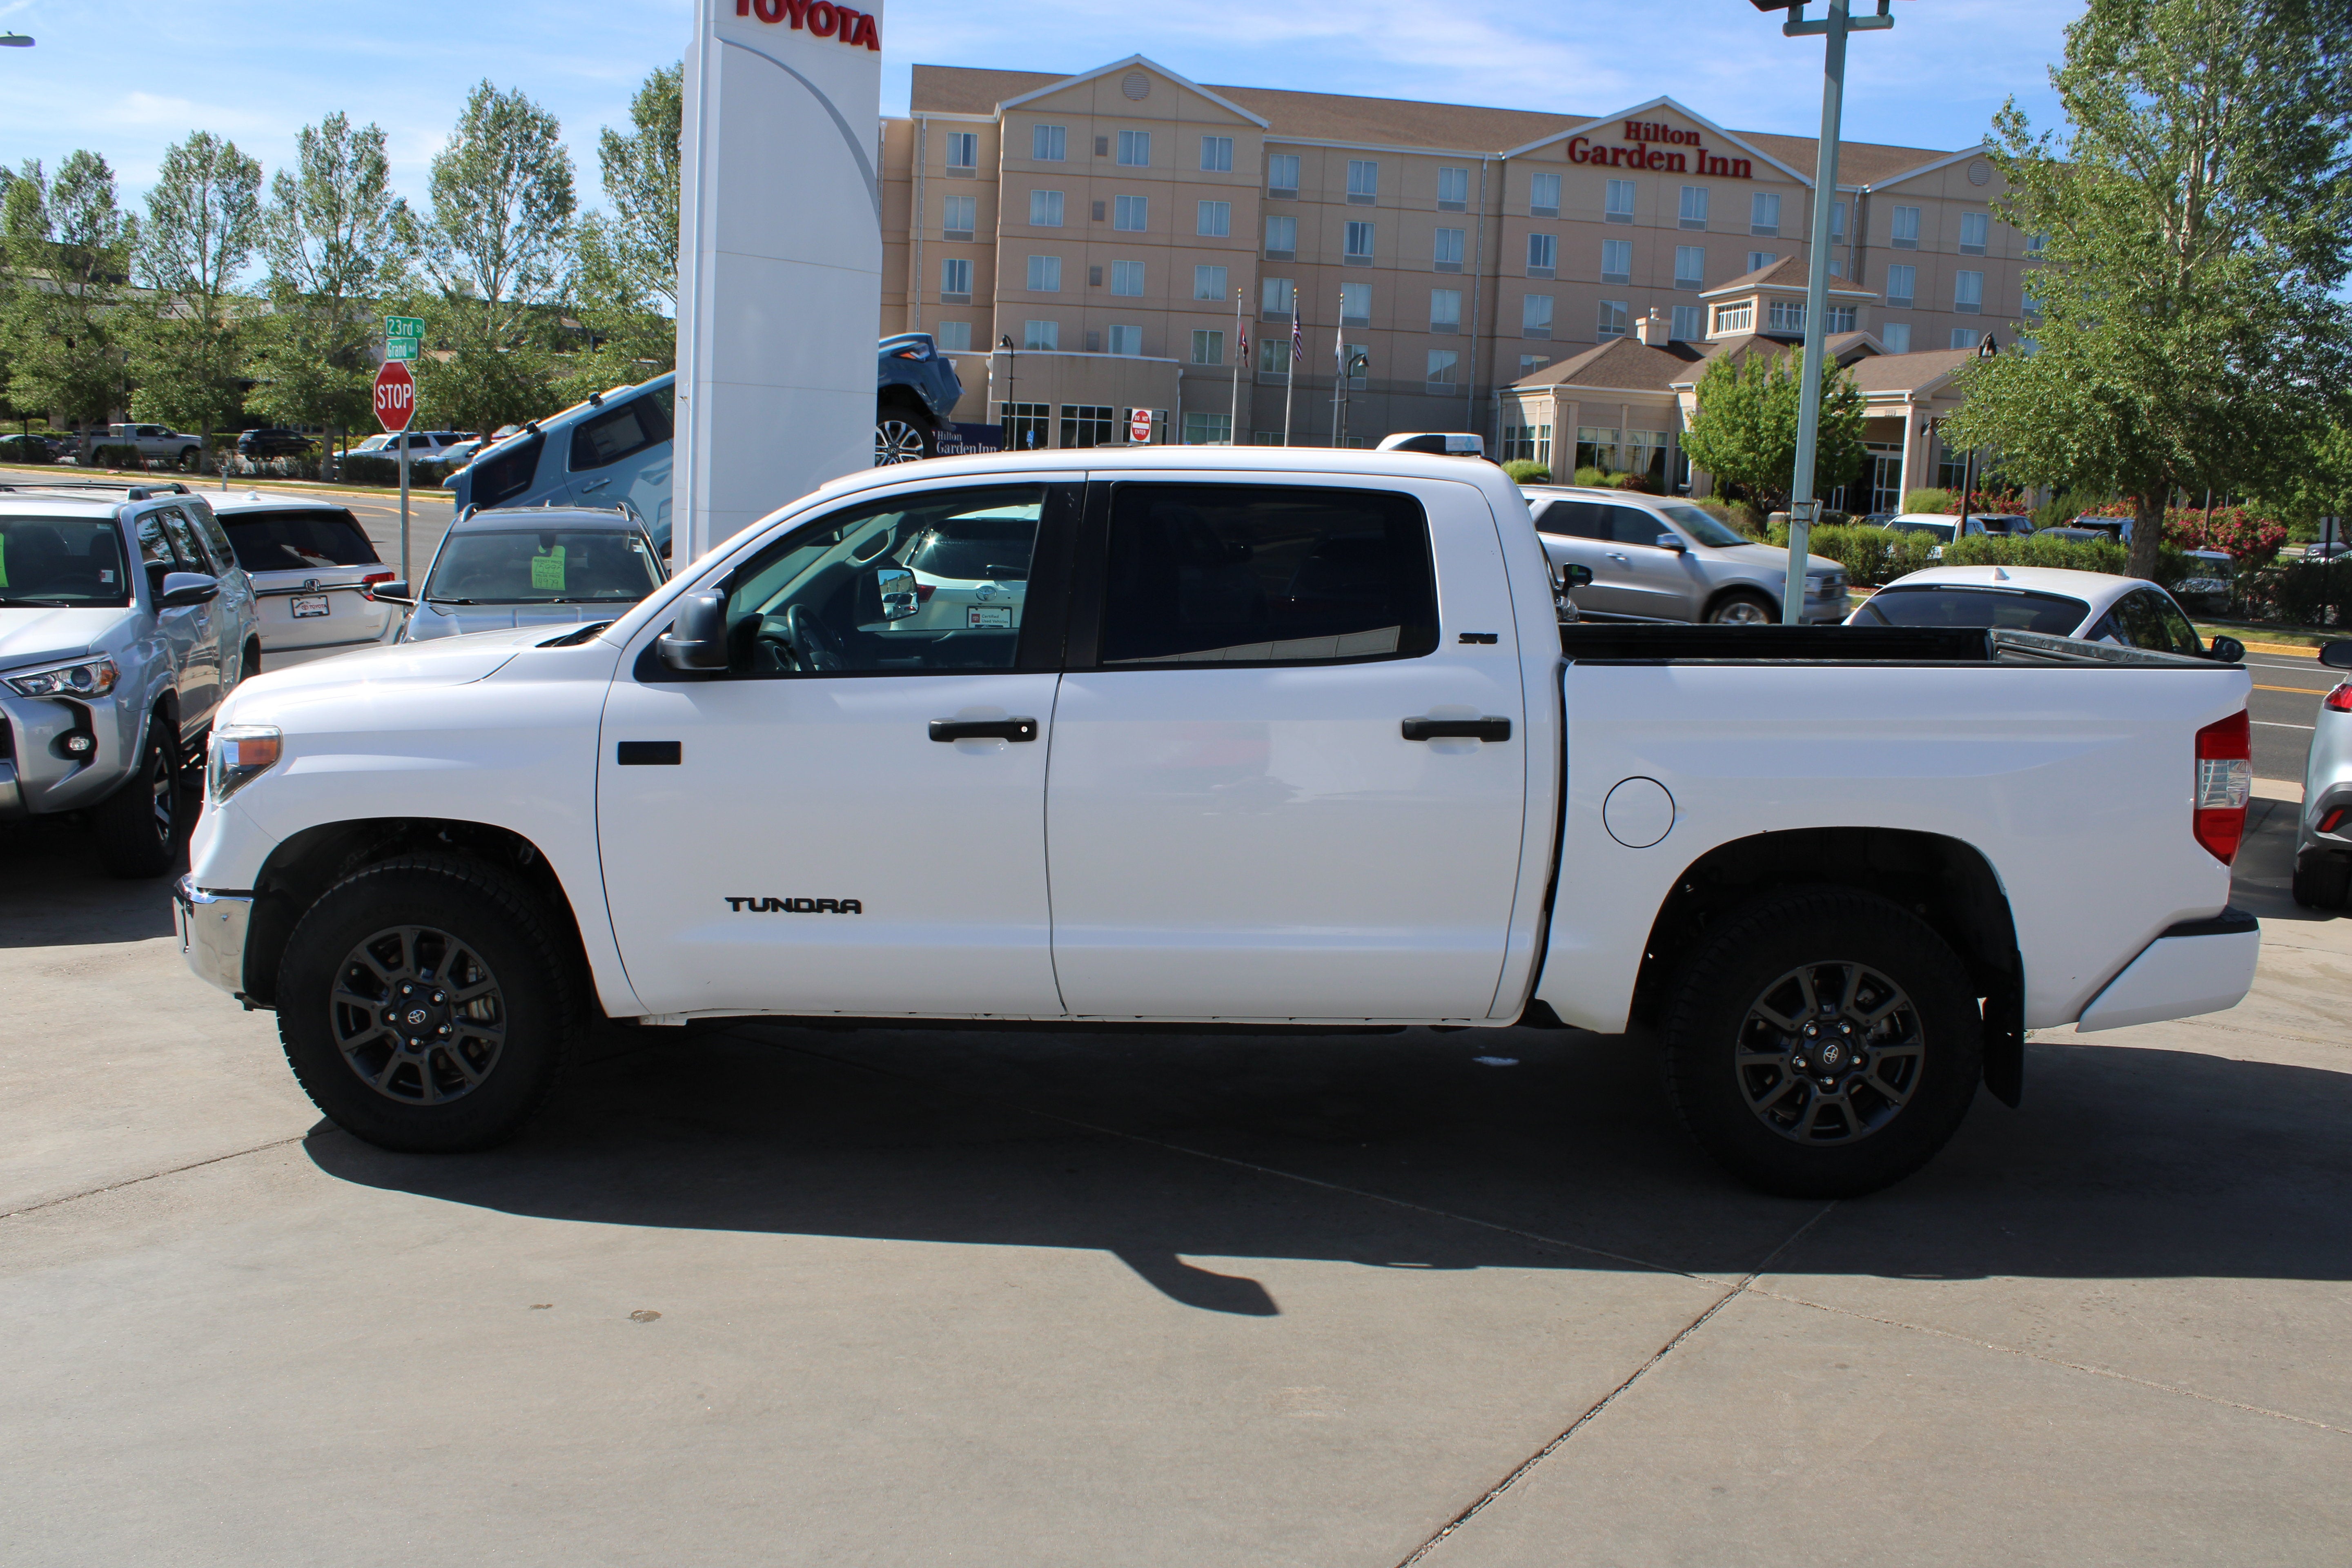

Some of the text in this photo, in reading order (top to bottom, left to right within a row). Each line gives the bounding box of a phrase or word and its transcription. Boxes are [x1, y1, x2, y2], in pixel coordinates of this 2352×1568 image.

[1624, 121, 1701, 146] Hilton
[1568, 137, 1753, 178] Garden Inn
[388, 318, 422, 336] 23rd St
[388, 341, 407, 358] Grand
[377, 383, 412, 409] STOP
[938, 430, 962, 441] Hilton
[936, 441, 997, 454] Garden Inn
[724, 897, 862, 914] TUNDRA
